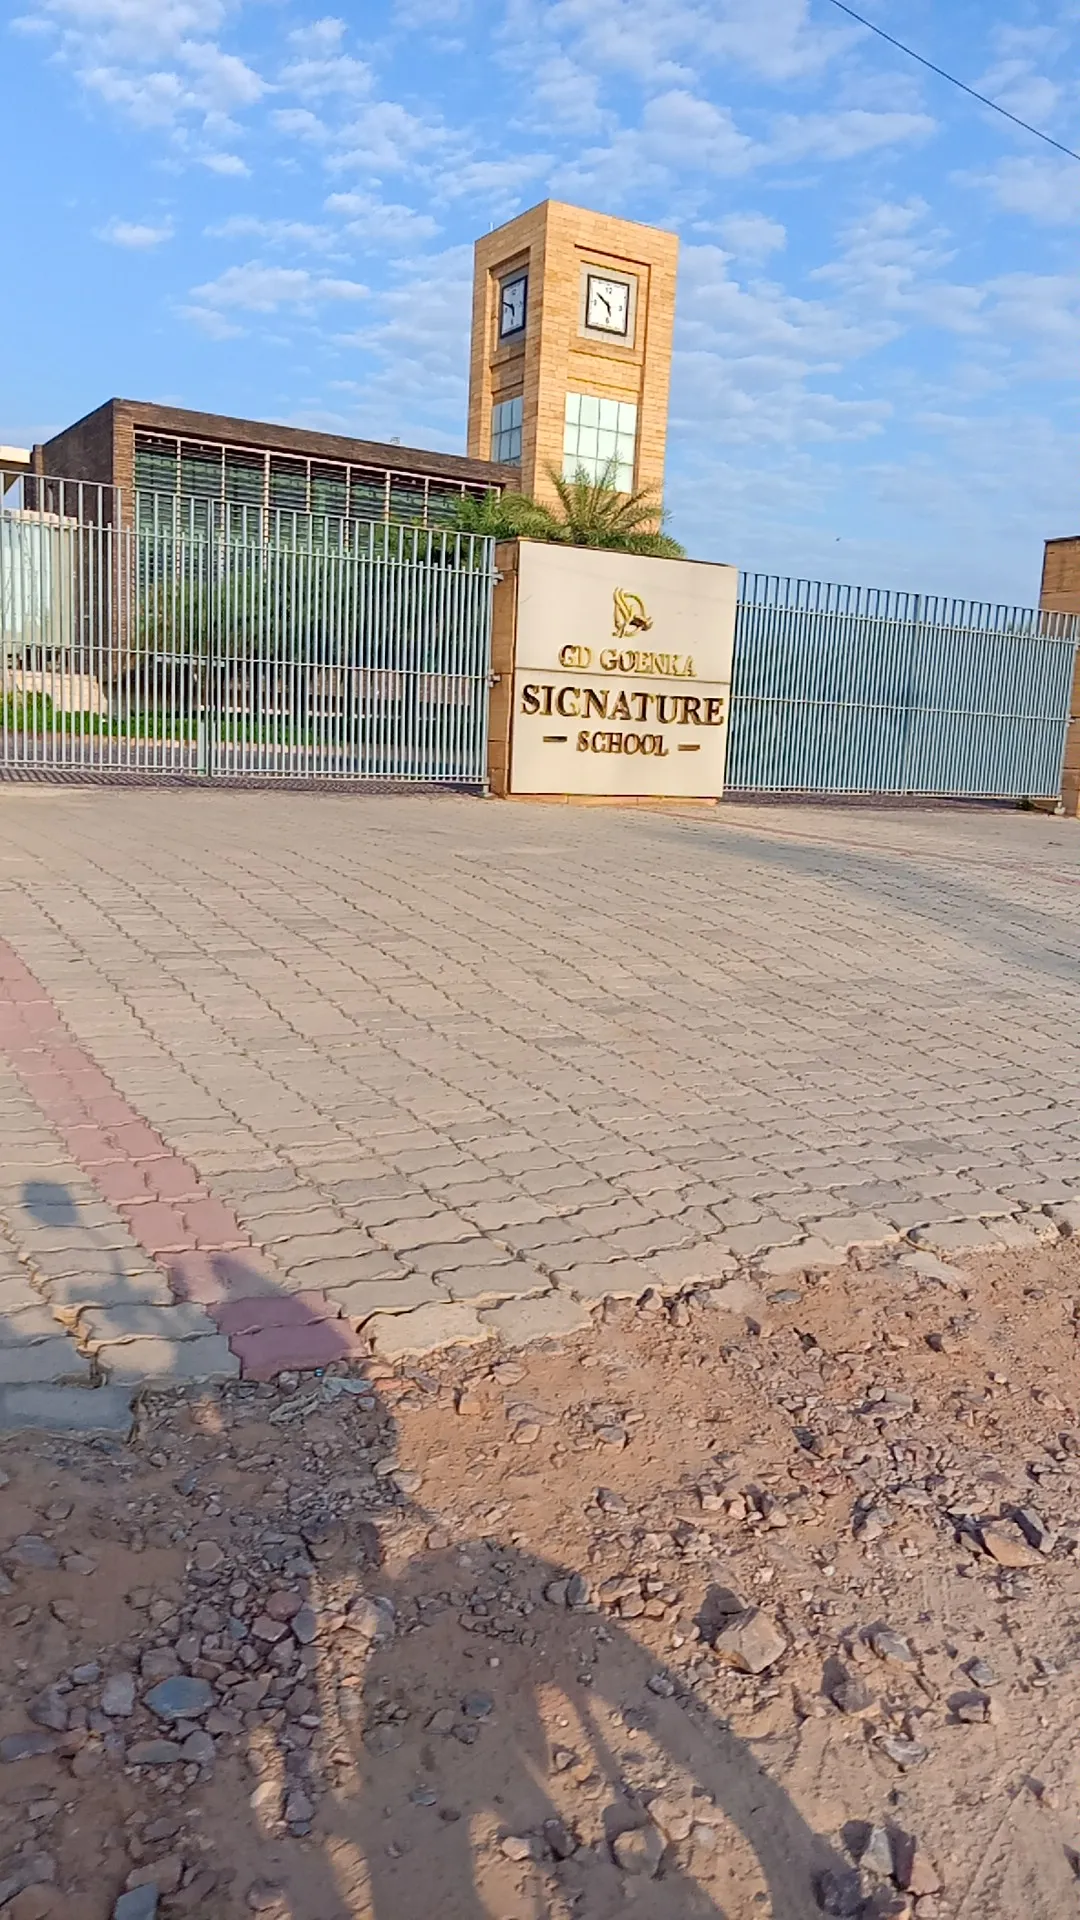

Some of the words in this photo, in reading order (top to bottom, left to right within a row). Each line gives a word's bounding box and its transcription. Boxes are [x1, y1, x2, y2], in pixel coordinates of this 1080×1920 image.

[559, 644, 592, 669] GD
[600, 648, 697, 677] GOENKA
[520, 684, 724, 726] SIGNATURE
[576, 730, 669, 757] SCHOOL
